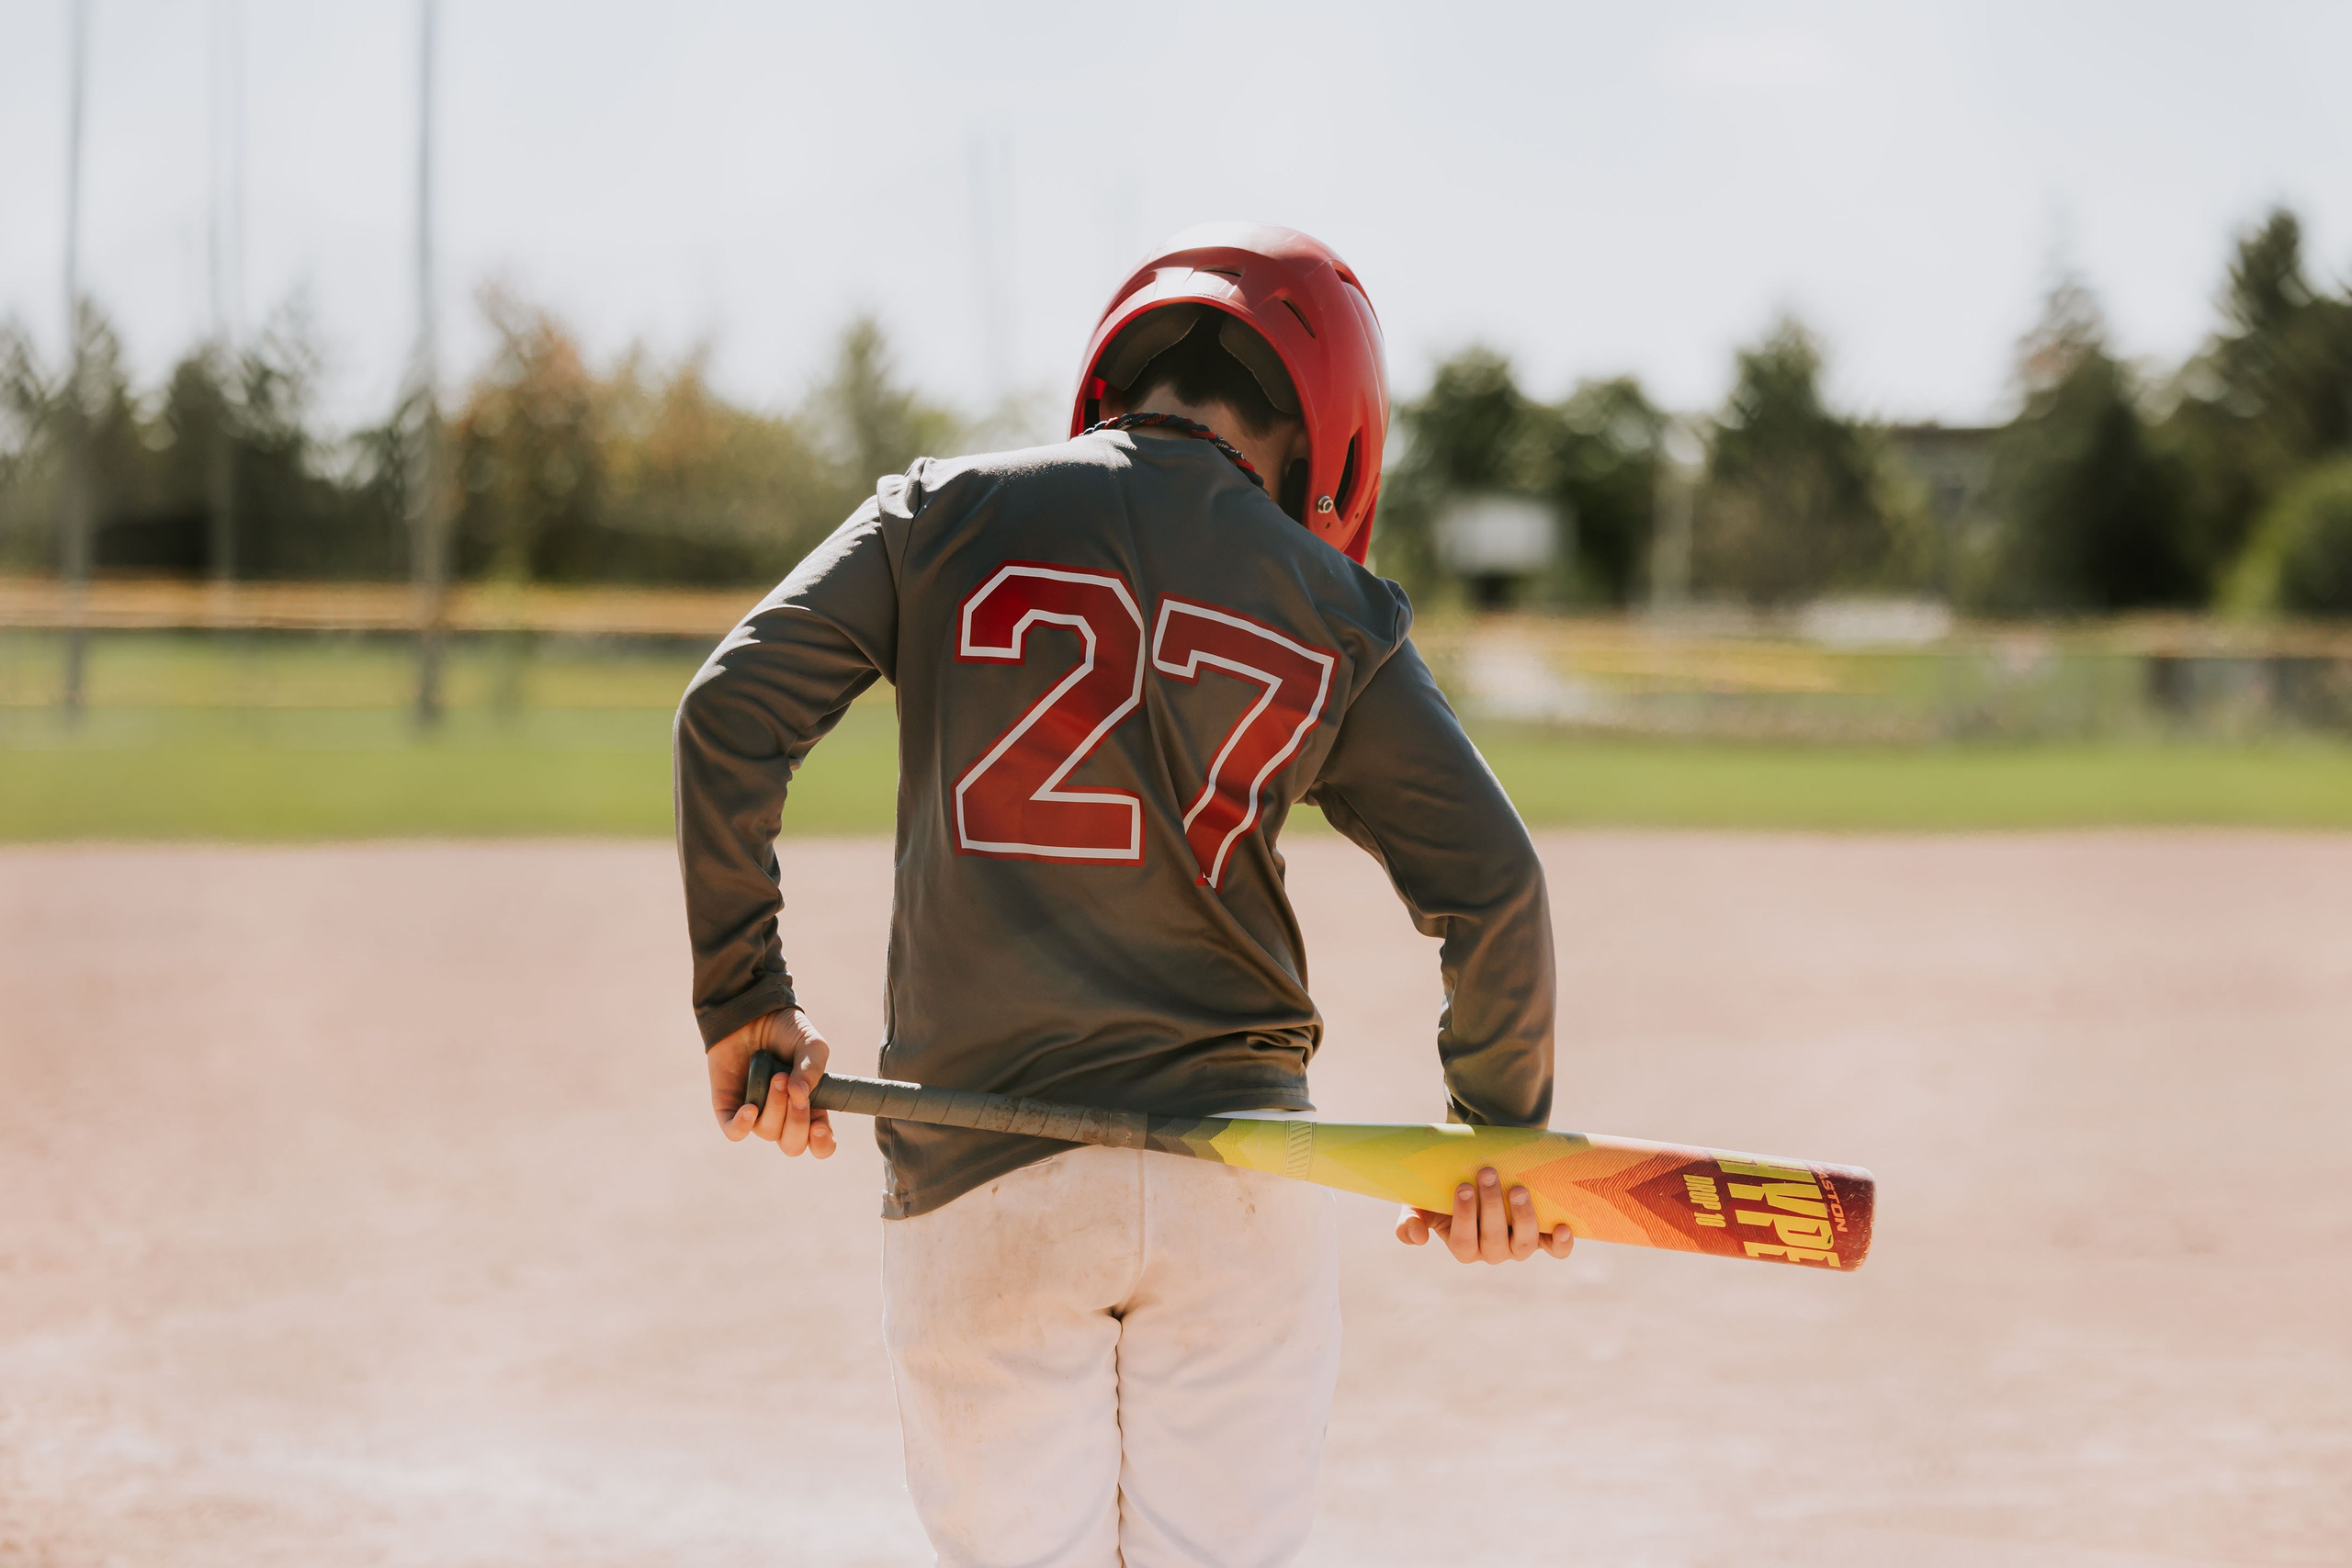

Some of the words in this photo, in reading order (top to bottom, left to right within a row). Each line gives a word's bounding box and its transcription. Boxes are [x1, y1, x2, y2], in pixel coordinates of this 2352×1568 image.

[952, 559, 1340, 895] 27
[1682, 1174, 1722, 1211] DROP
[1693, 1212, 1726, 1228] 10
[1706, 1150, 1841, 1268] HYPE
